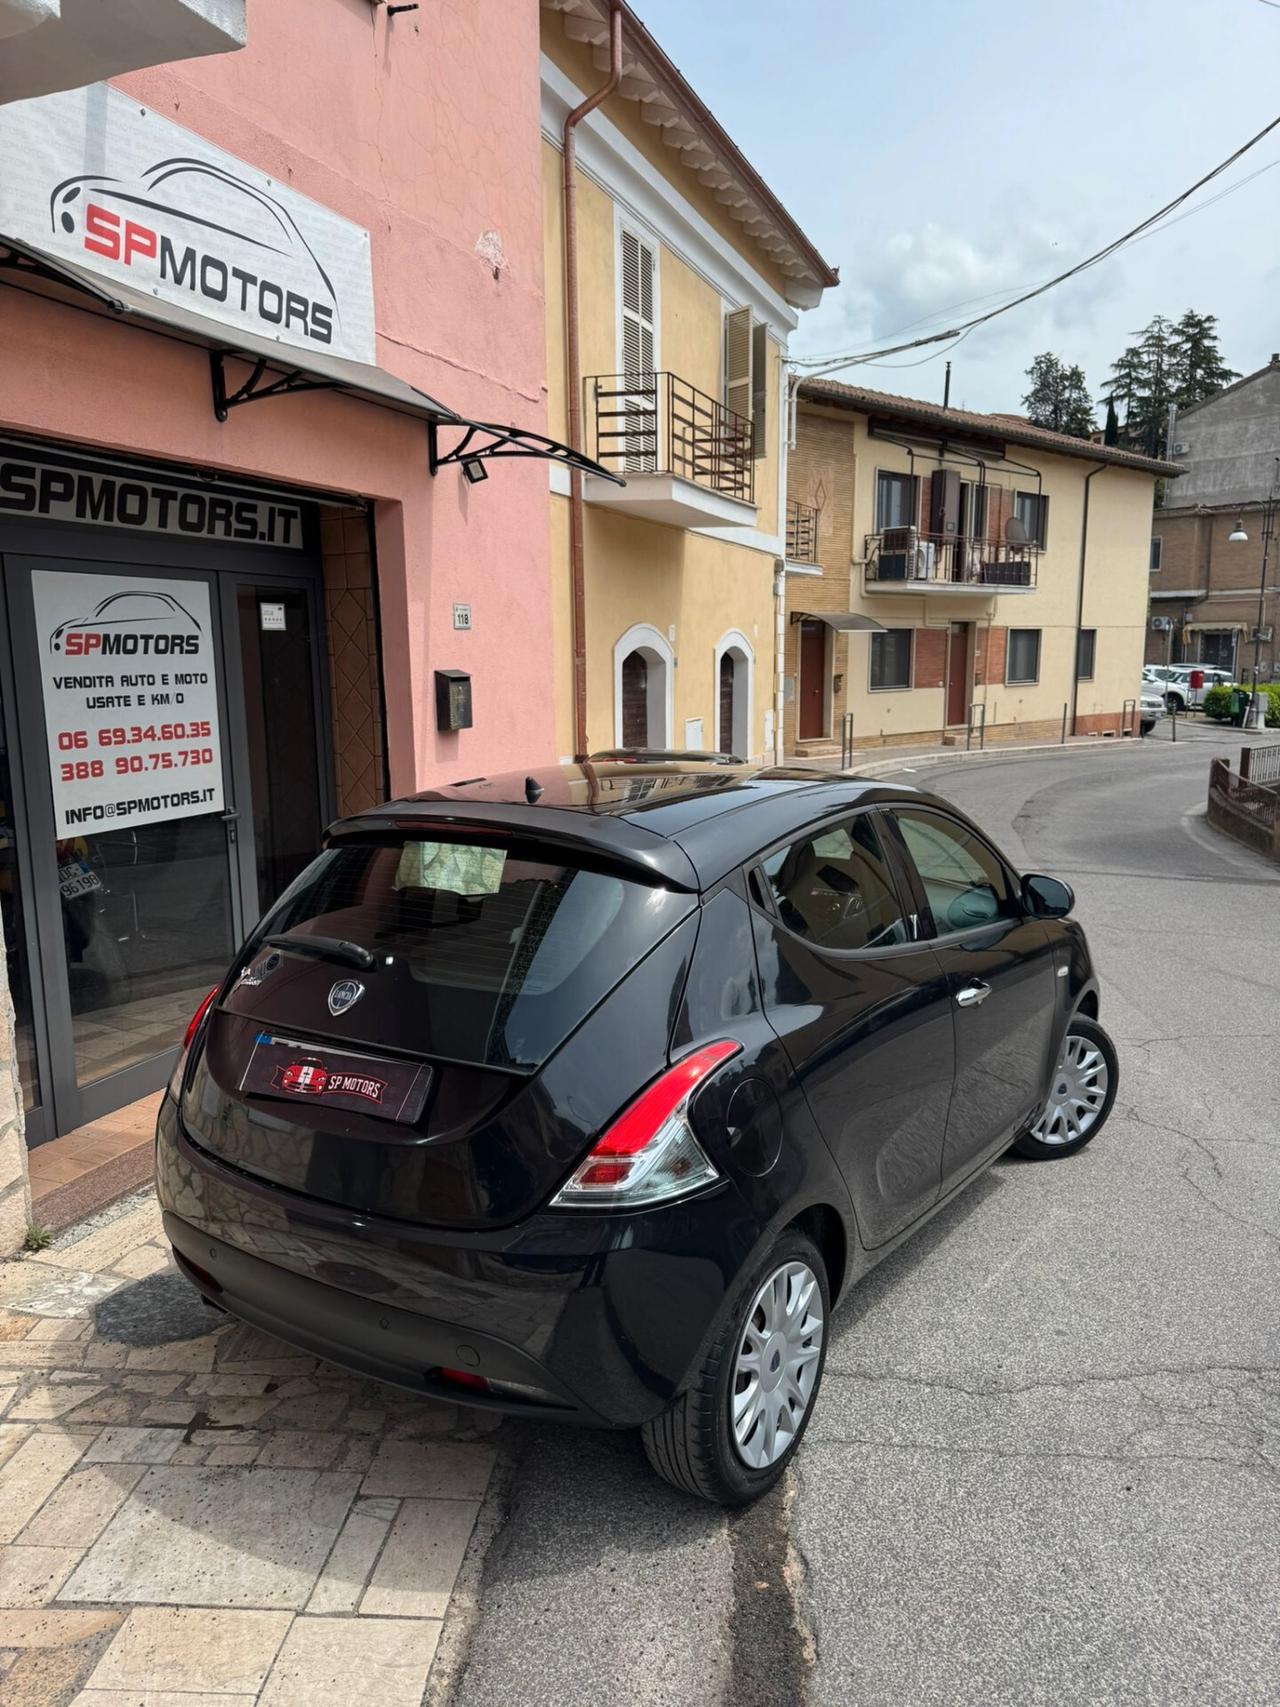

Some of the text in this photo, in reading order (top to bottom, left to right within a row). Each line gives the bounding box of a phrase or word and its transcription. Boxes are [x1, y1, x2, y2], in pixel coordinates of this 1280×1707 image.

[84, 203, 333, 344] SPMOTORS
[0, 463, 298, 544] SPMOTORS.IT
[457, 613, 469, 625] 118
[65, 633, 199, 655] SPMOTORS
[53, 673, 208, 689] VENDITA AUTO E MOTO
[86, 695, 132, 709] USATE
[137, 695, 145, 706] E
[58, 721, 211, 750] 06 69.34.60.35
[60, 748, 213, 781] 388 90.75.730
[65, 788, 215, 825] INFO@SPMOTORS.IT
[328, 1075, 380, 1098] SP MOTORS
